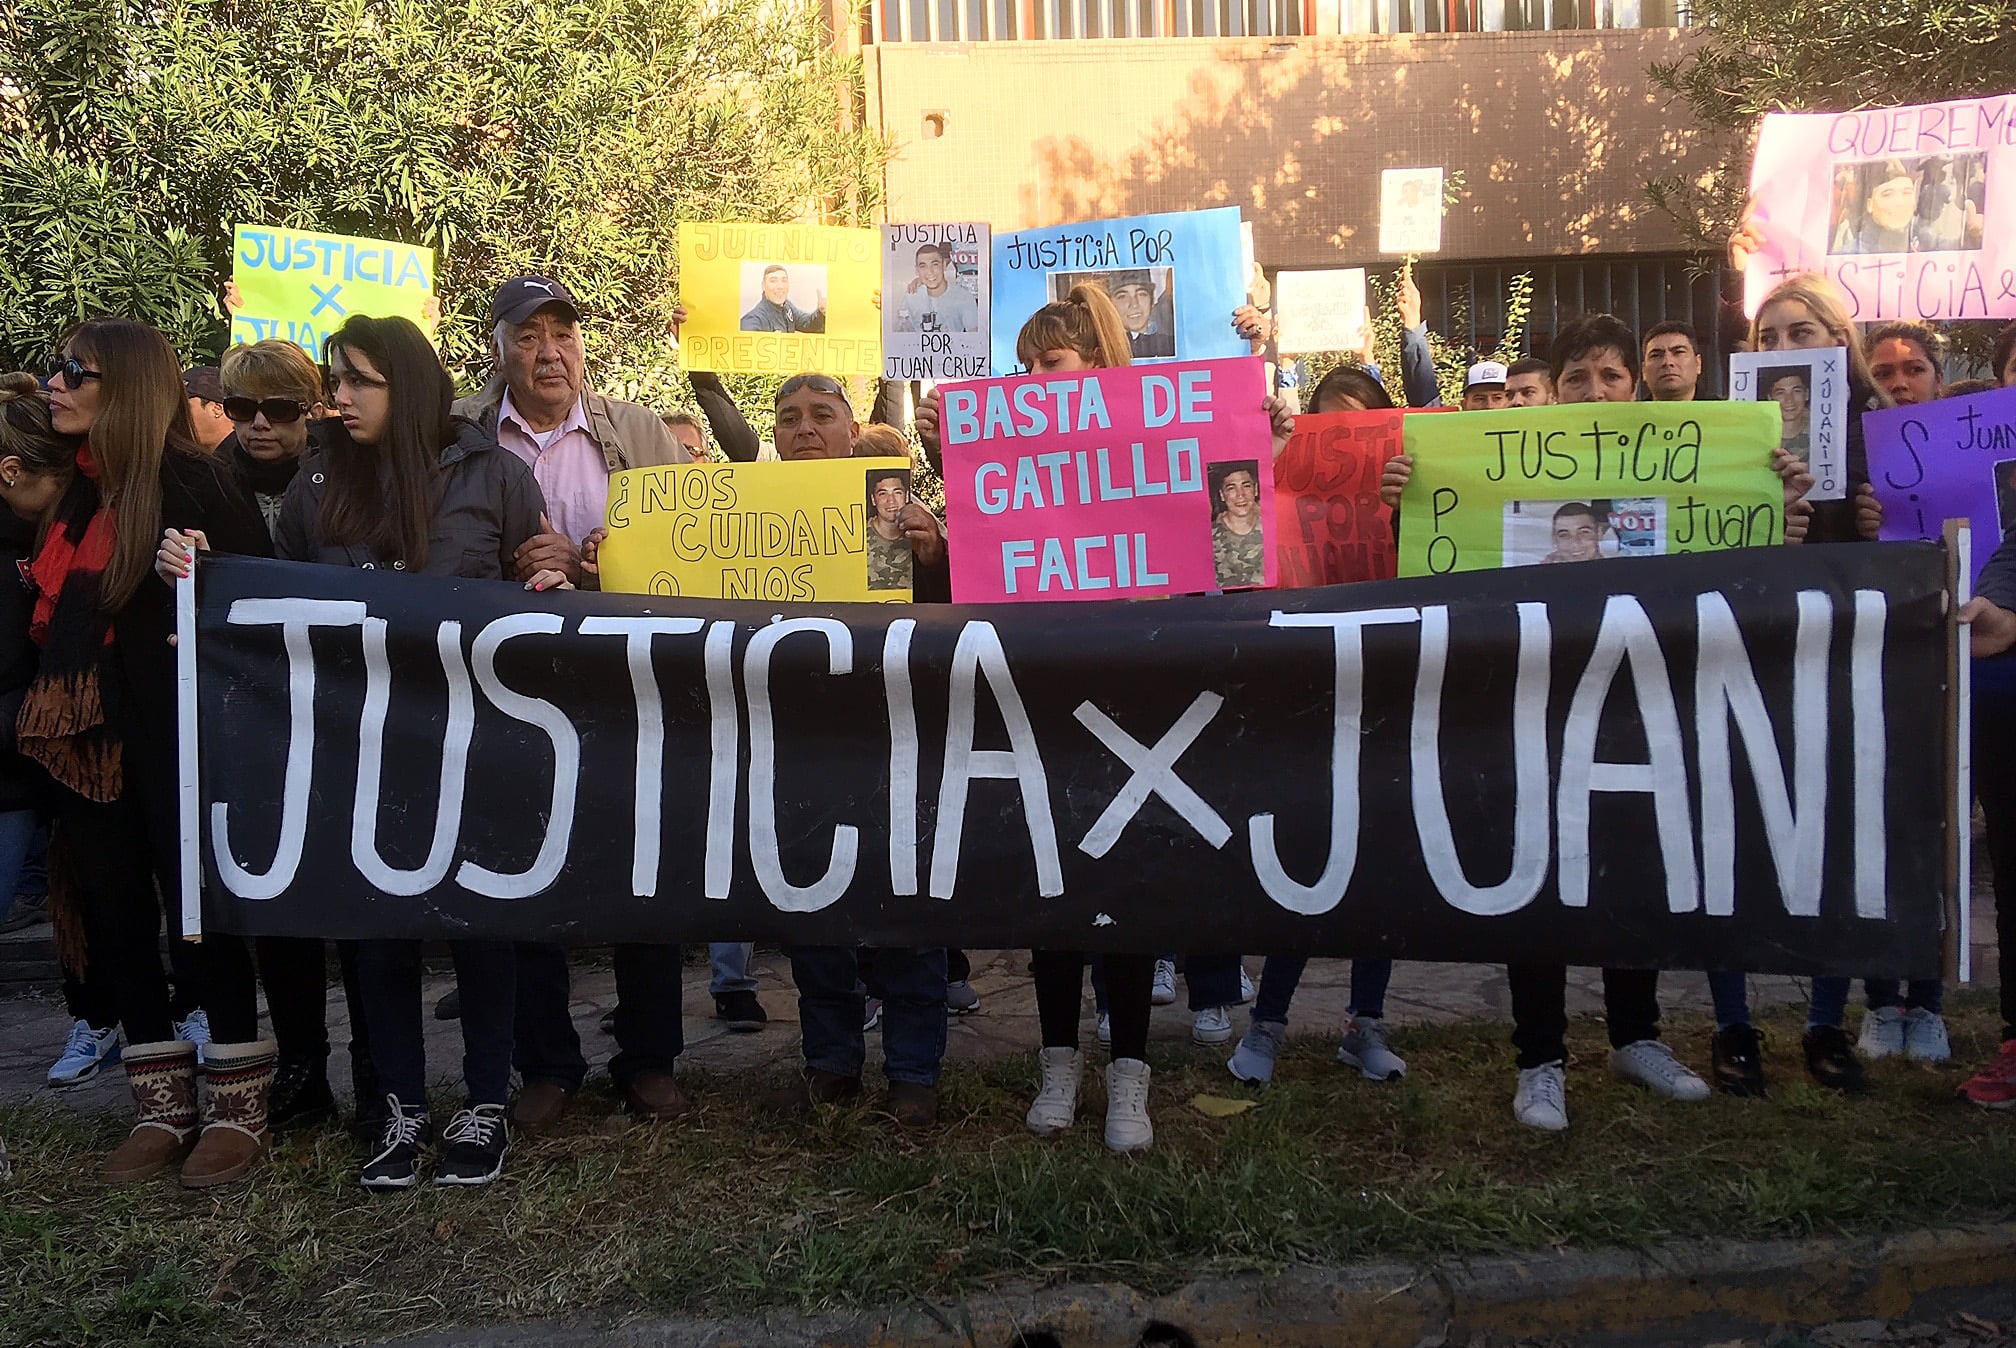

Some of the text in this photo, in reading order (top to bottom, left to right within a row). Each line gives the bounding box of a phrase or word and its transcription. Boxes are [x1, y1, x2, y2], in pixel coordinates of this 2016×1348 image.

[240, 231, 429, 288] JUSTICIA
[890, 223, 978, 244] JUSTICIA
[1129, 228, 1175, 265] POR
[687, 336, 879, 372] PRESENTE
[886, 357, 933, 379] JUAN
[942, 355, 987, 378] CRUZ
[921, 334, 953, 355] POR
[944, 369, 1213, 445] BASTA DE
[608, 468, 738, 529] ¿NOS
[974, 437, 1203, 515] GATILLO
[671, 503, 865, 563] CUIDAN
[1295, 492, 1387, 543] POR
[721, 564, 816, 602] NOS
[1001, 532, 1169, 594] FACIL
[210, 597, 1064, 913] JUSTICIA
[1248, 588, 1889, 920] JUANI
